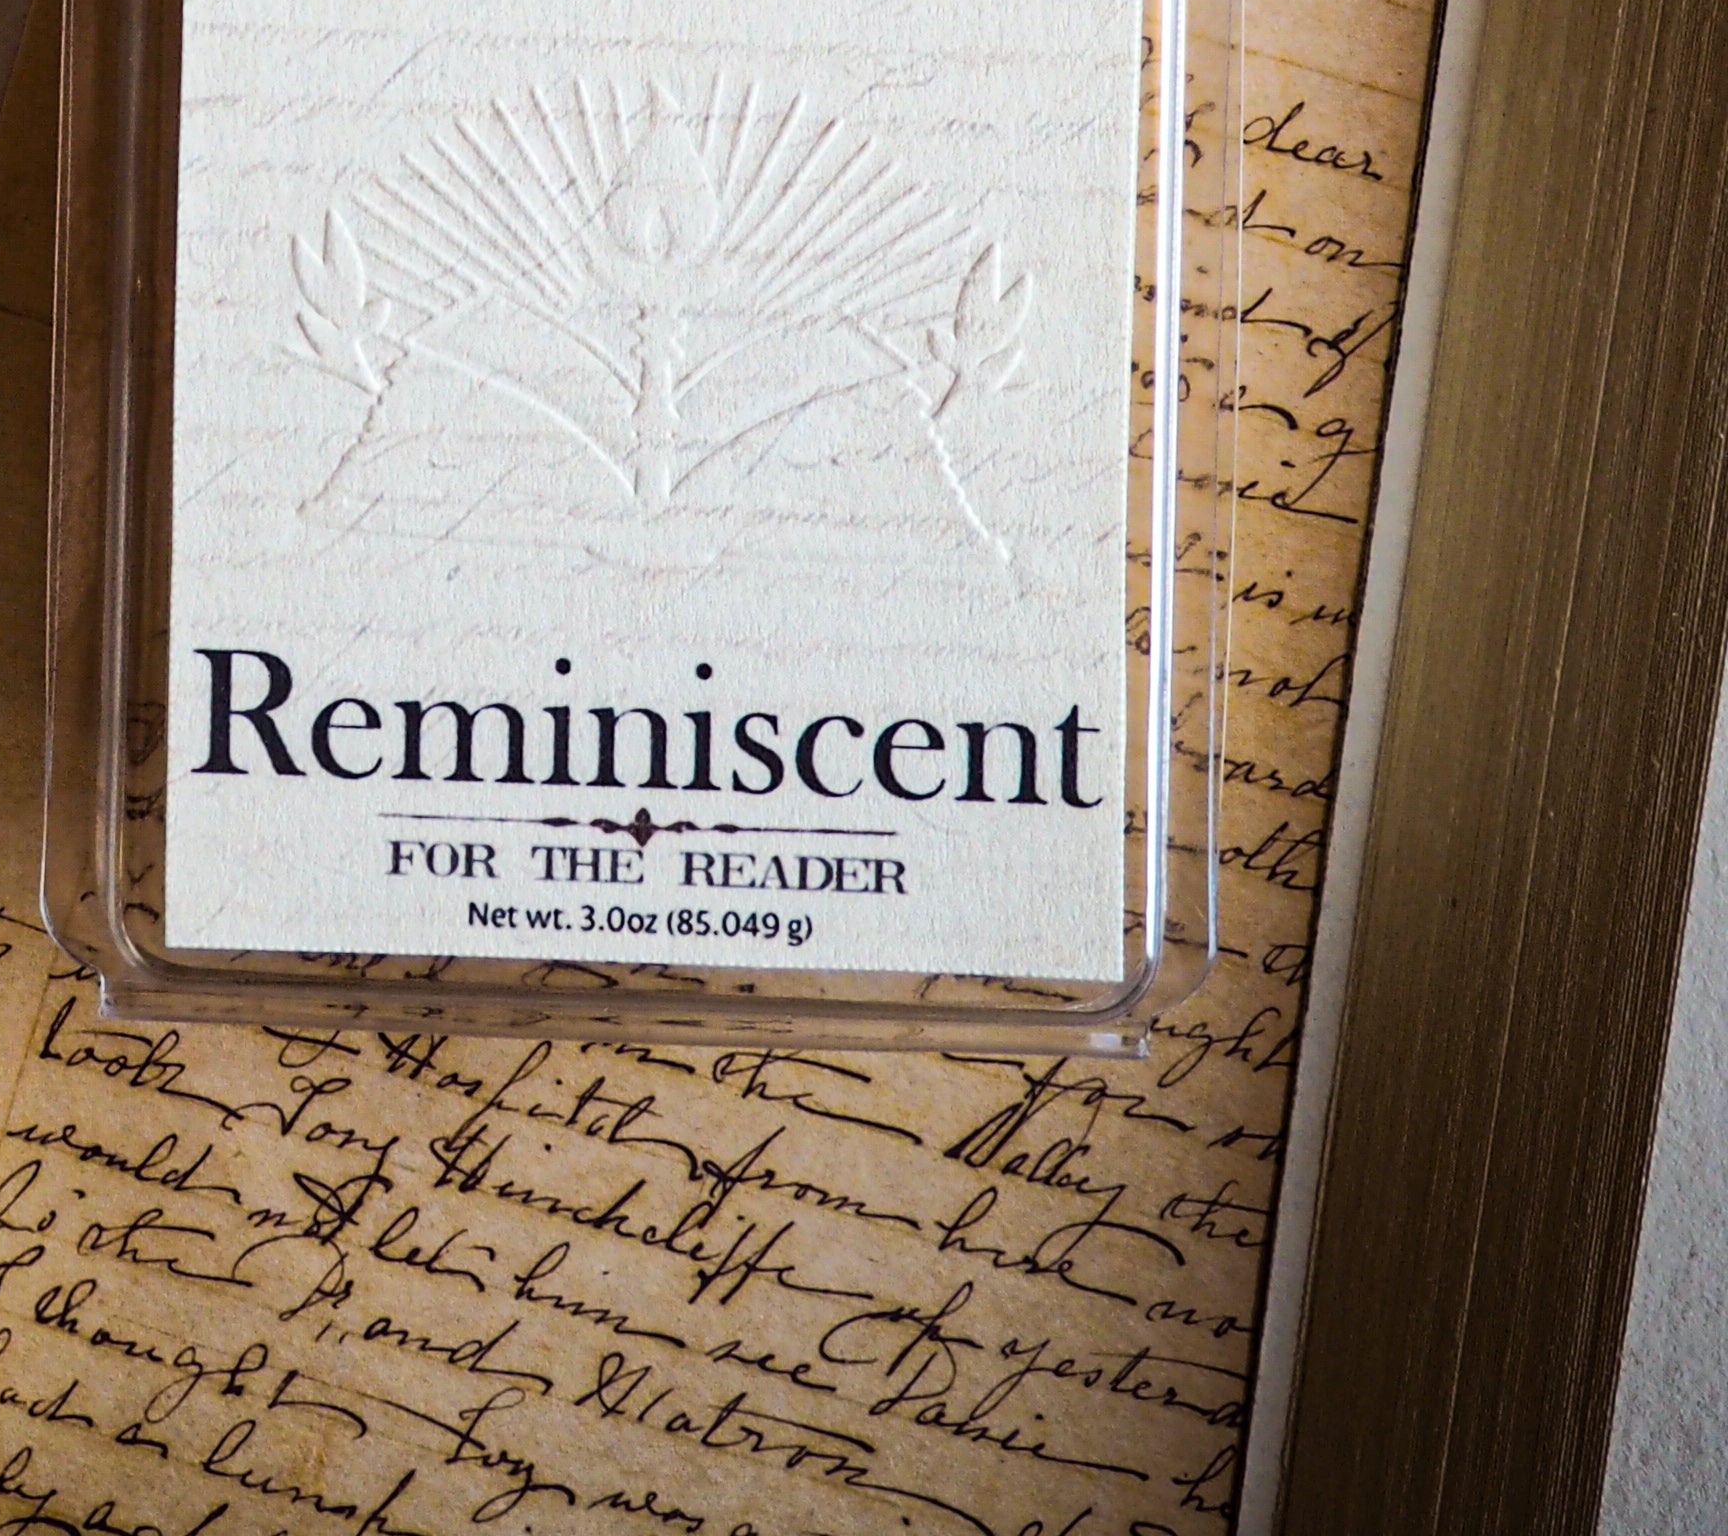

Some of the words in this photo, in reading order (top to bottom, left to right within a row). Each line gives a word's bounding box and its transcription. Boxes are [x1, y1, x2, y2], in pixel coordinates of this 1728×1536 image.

[191, 649, 1103, 808] Reminiscent
[389, 841, 496, 878] FOR
[532, 842, 647, 883] THE
[683, 852, 905, 894] READER
[467, 900, 519, 930] Net
[524, 907, 573, 932] wt.
[579, 903, 659, 935] 3.0oz
